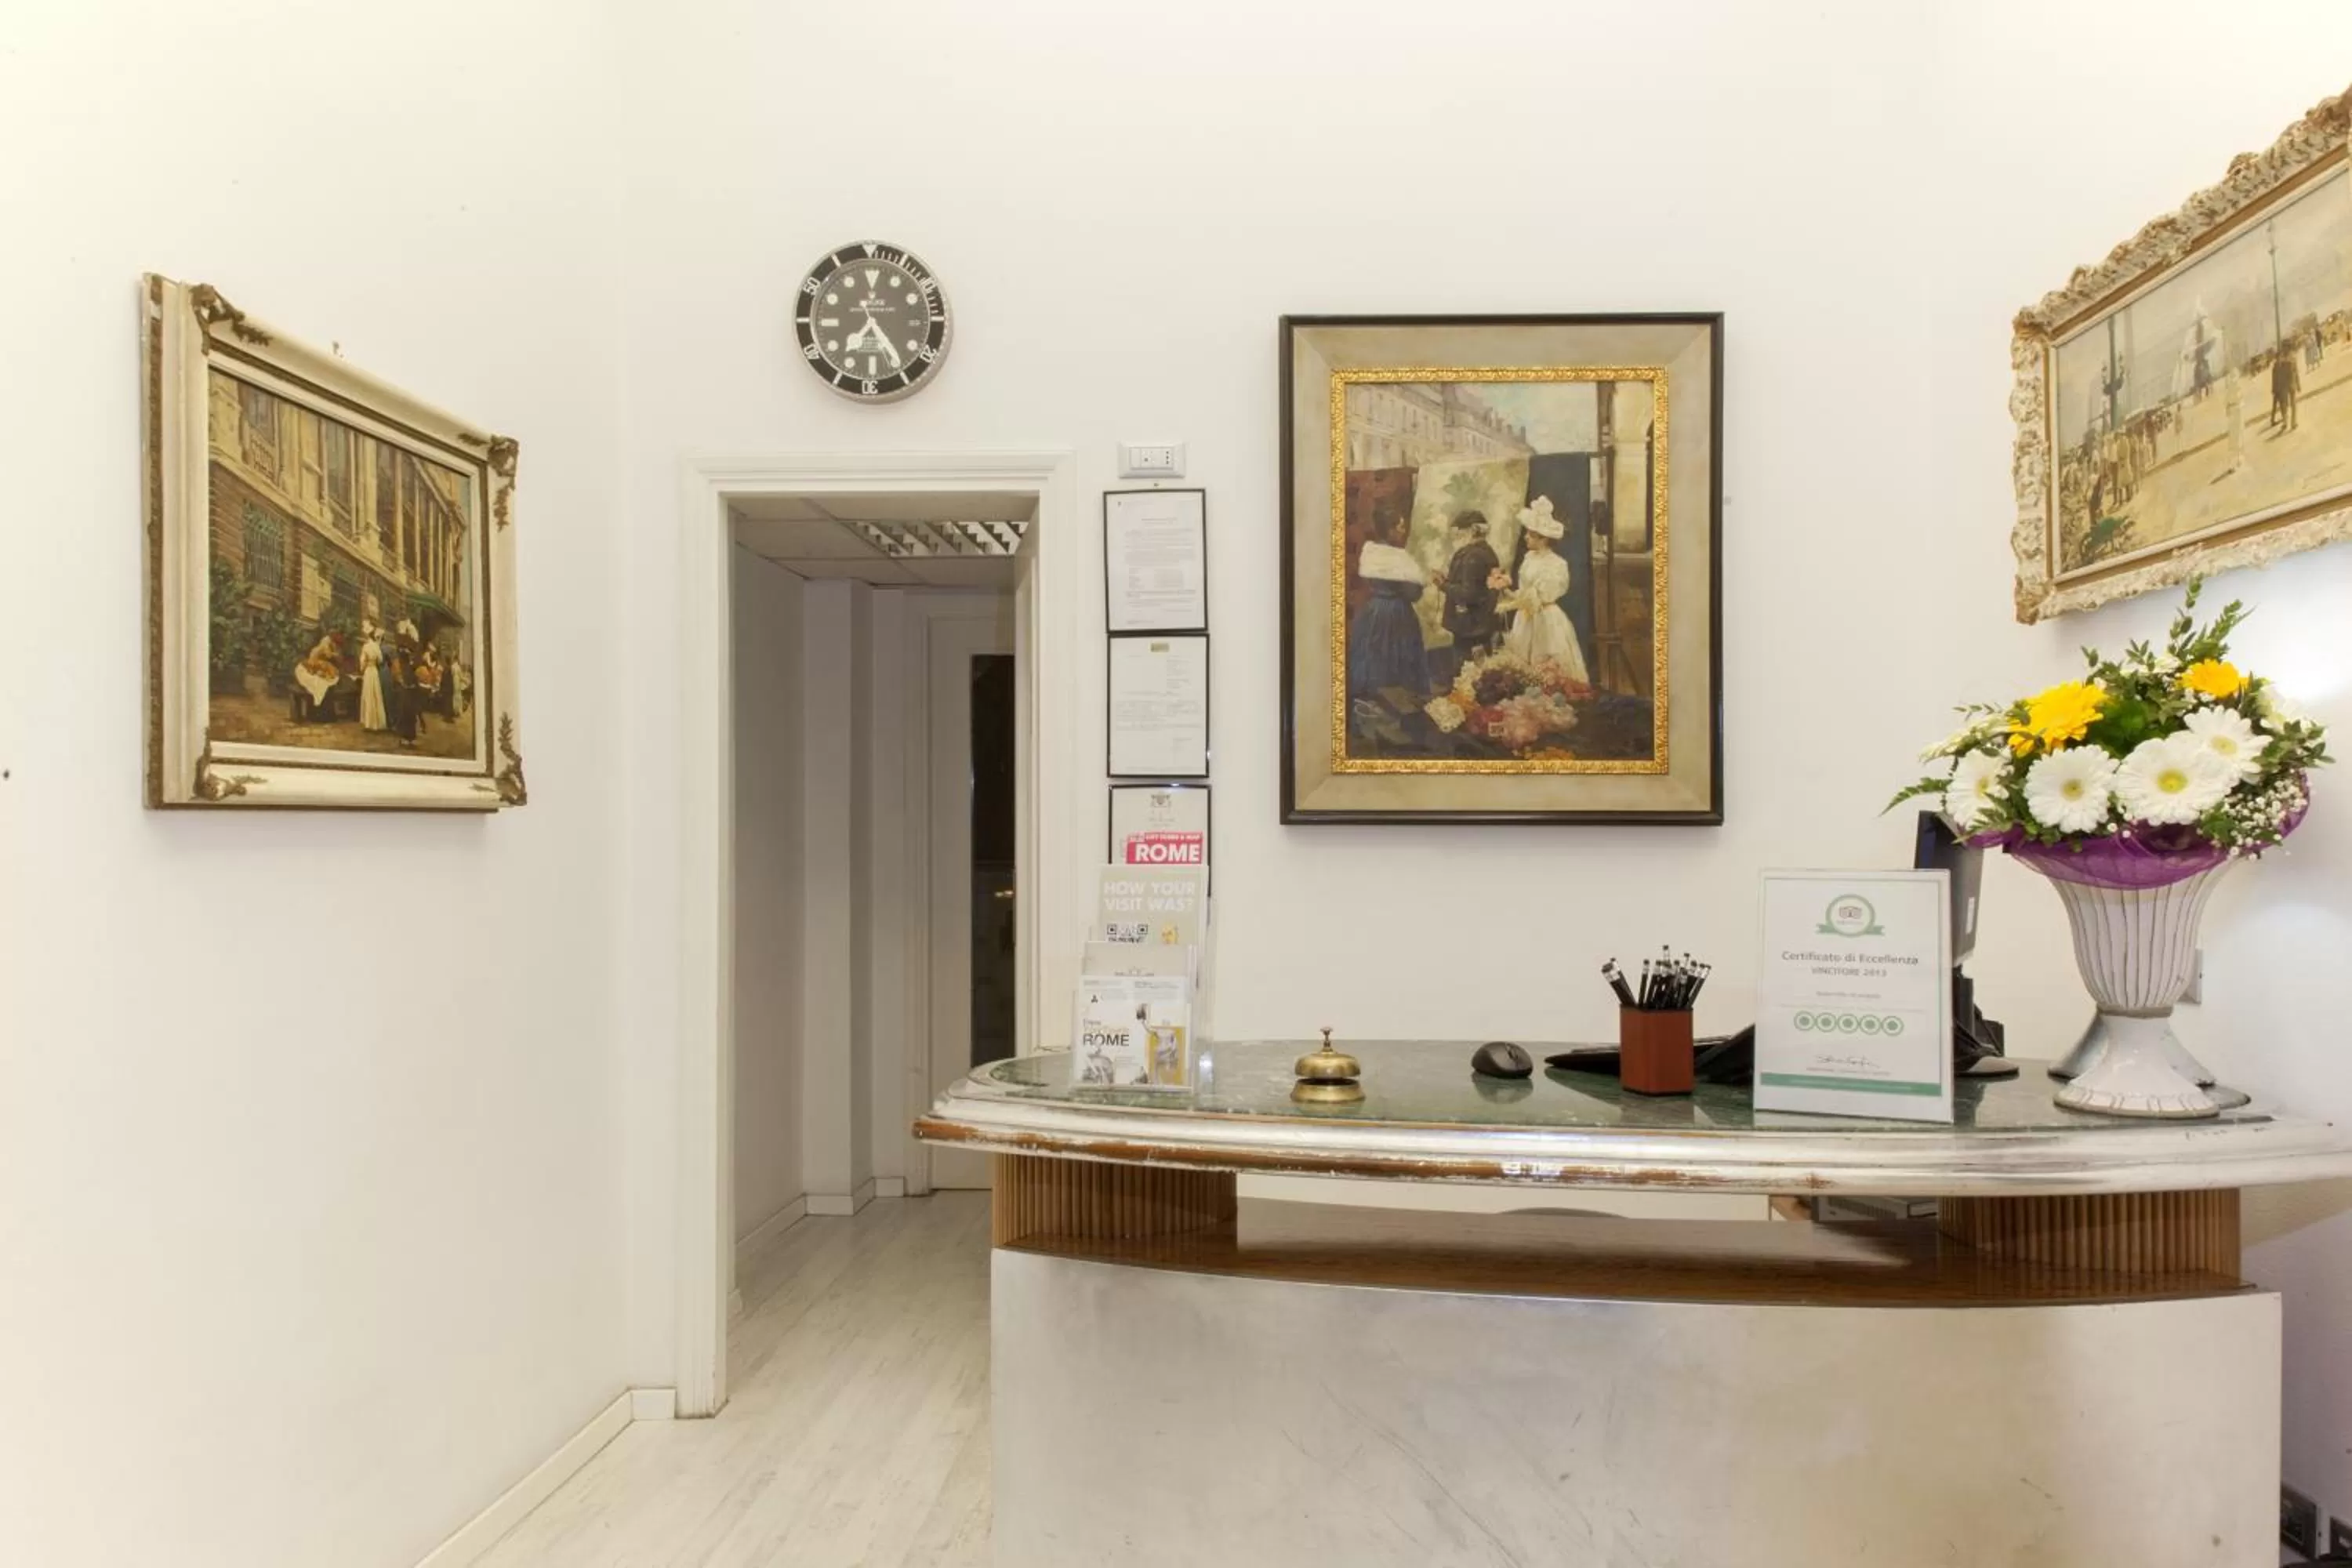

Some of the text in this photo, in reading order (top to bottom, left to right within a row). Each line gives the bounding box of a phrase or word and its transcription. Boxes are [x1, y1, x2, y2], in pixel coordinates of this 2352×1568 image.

[1135, 843, 1200, 862] ROME
[1103, 881, 1196, 895] HOW YOUR
[1104, 897, 1195, 911] VISIT WAS?
[1781, 950, 1918, 966] Certificato di Eccellenza
[1811, 966, 1860, 977] VINCITORE
[1083, 1033, 1130, 1047] ROME
